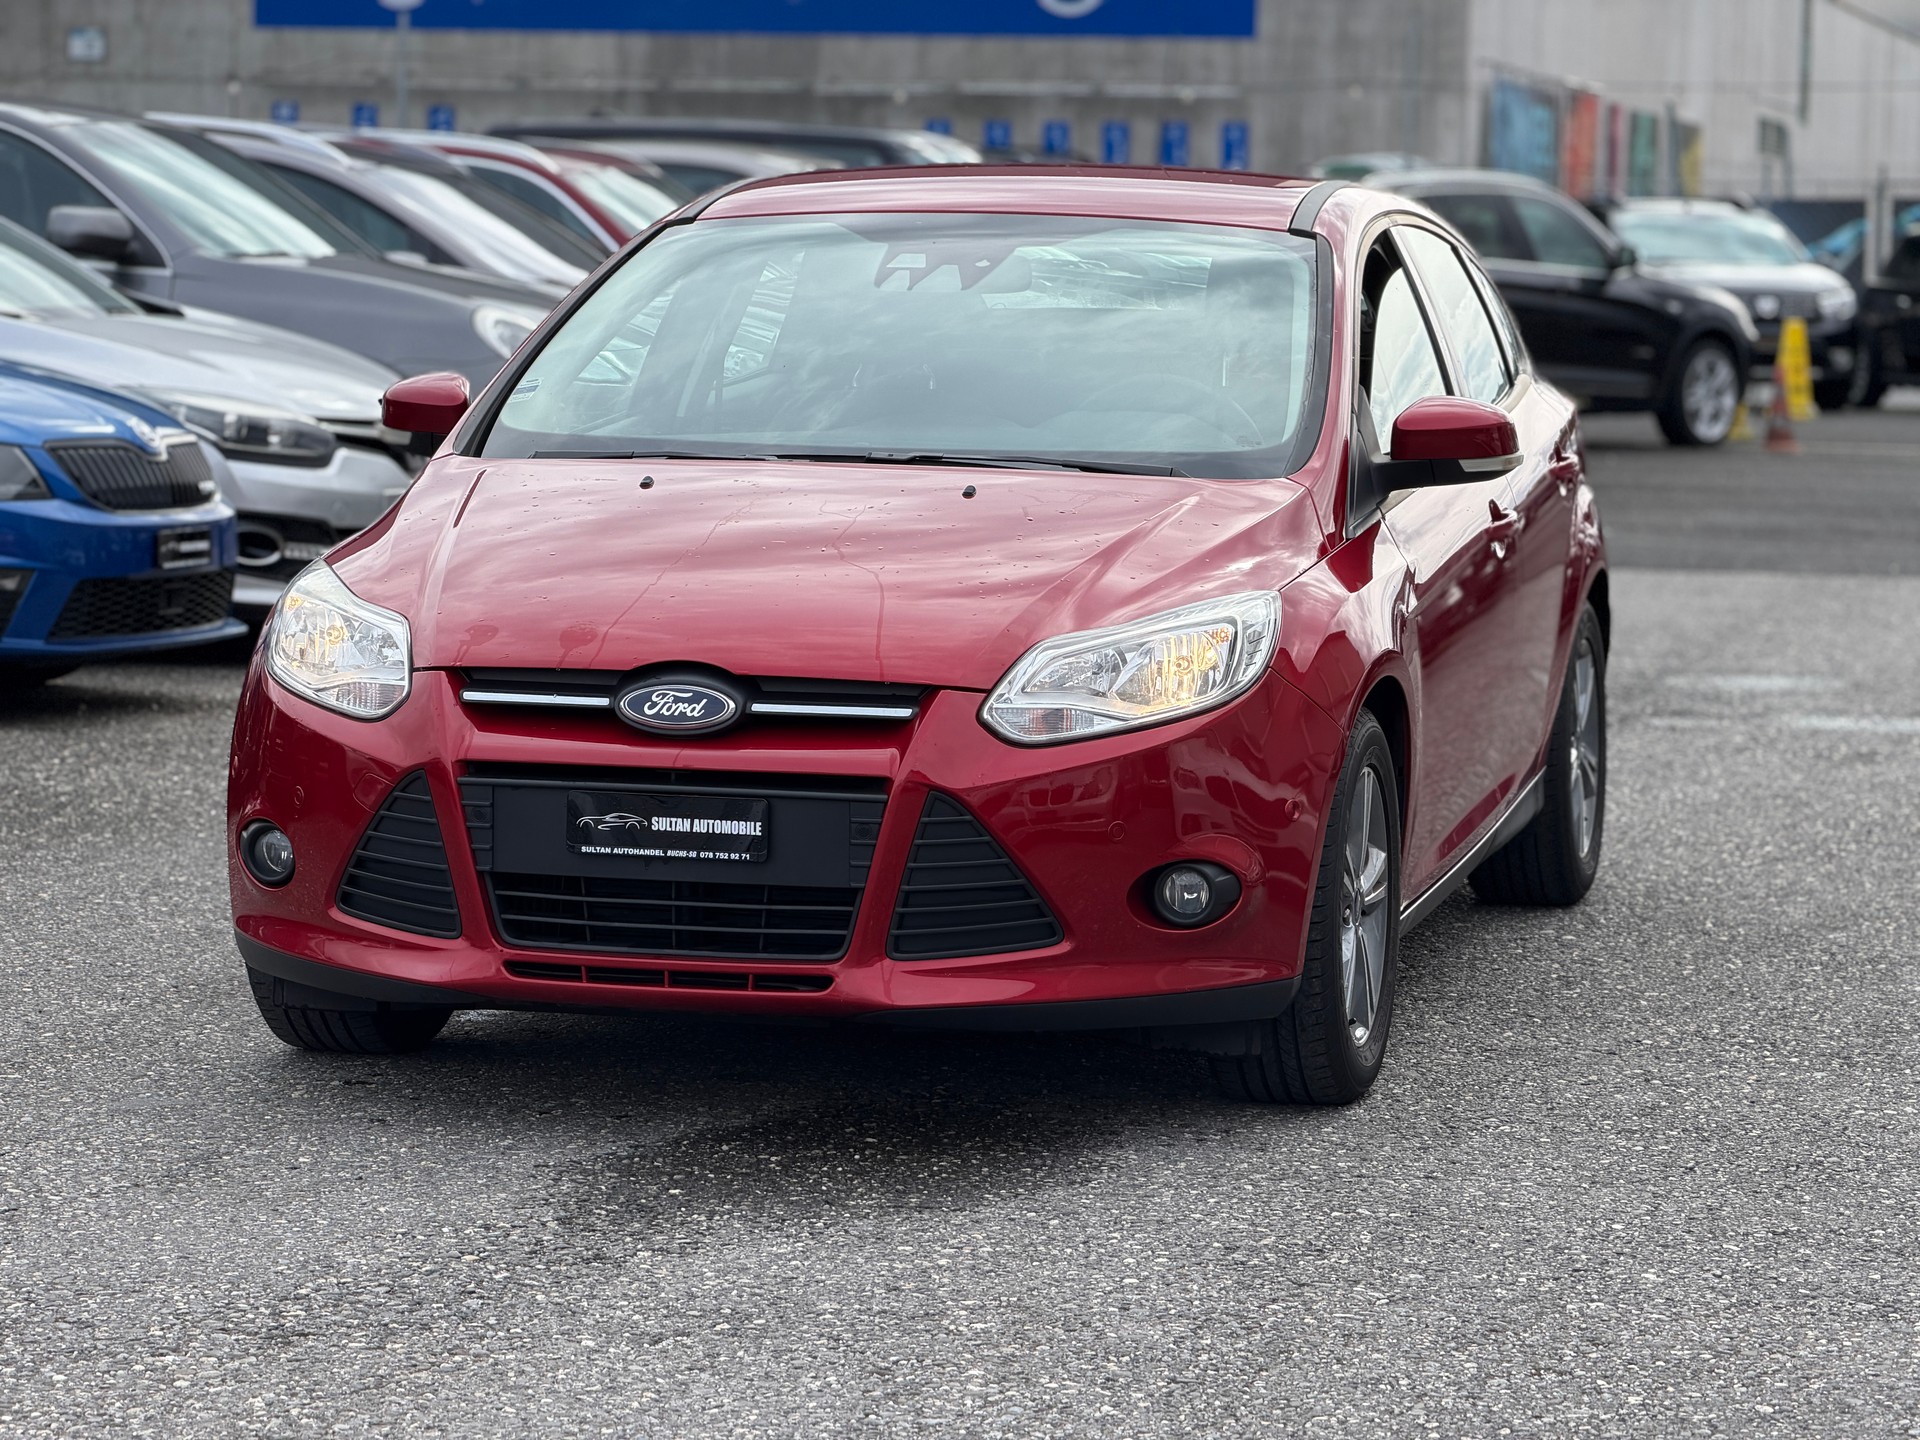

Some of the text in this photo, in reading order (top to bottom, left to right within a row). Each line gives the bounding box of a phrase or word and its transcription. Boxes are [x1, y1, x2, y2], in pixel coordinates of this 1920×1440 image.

[643, 690, 708, 717] Ford
[651, 816, 762, 836] SULTAN AUTOMOBILE
[581, 846, 611, 854] SULTAN
[612, 847, 665, 856] AUTOHANDEL
[666, 850, 698, 858] BUCHS-SG
[715, 852, 729, 860] 752
[741, 853, 750, 861] 71
